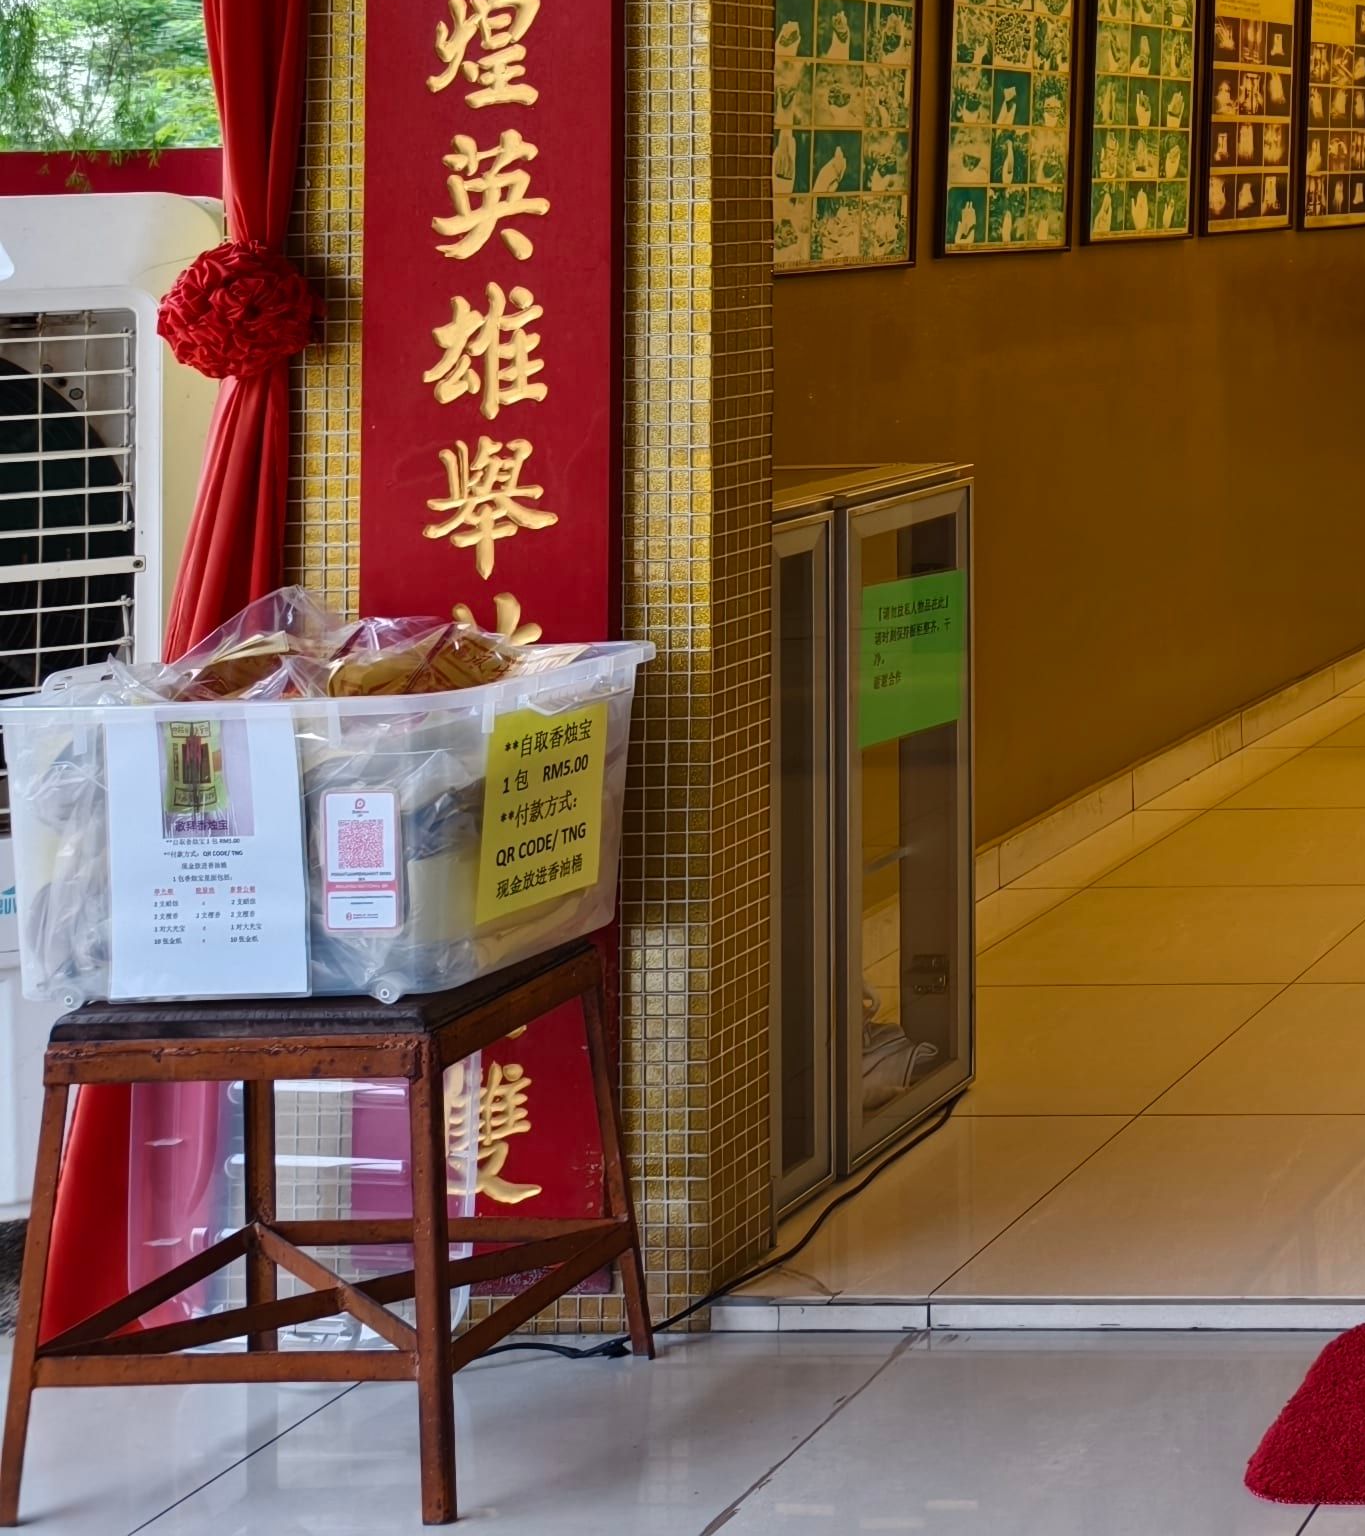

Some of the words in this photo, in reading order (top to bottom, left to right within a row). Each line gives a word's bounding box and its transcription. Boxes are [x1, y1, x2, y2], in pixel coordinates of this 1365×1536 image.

[502, 776, 510, 794] 1
[514, 768, 529, 793] 包
[542, 754, 590, 783] RM5.00
[496, 848, 515, 866] QR
[518, 828, 560, 859] CODE/
[561, 822, 587, 845] TNG
